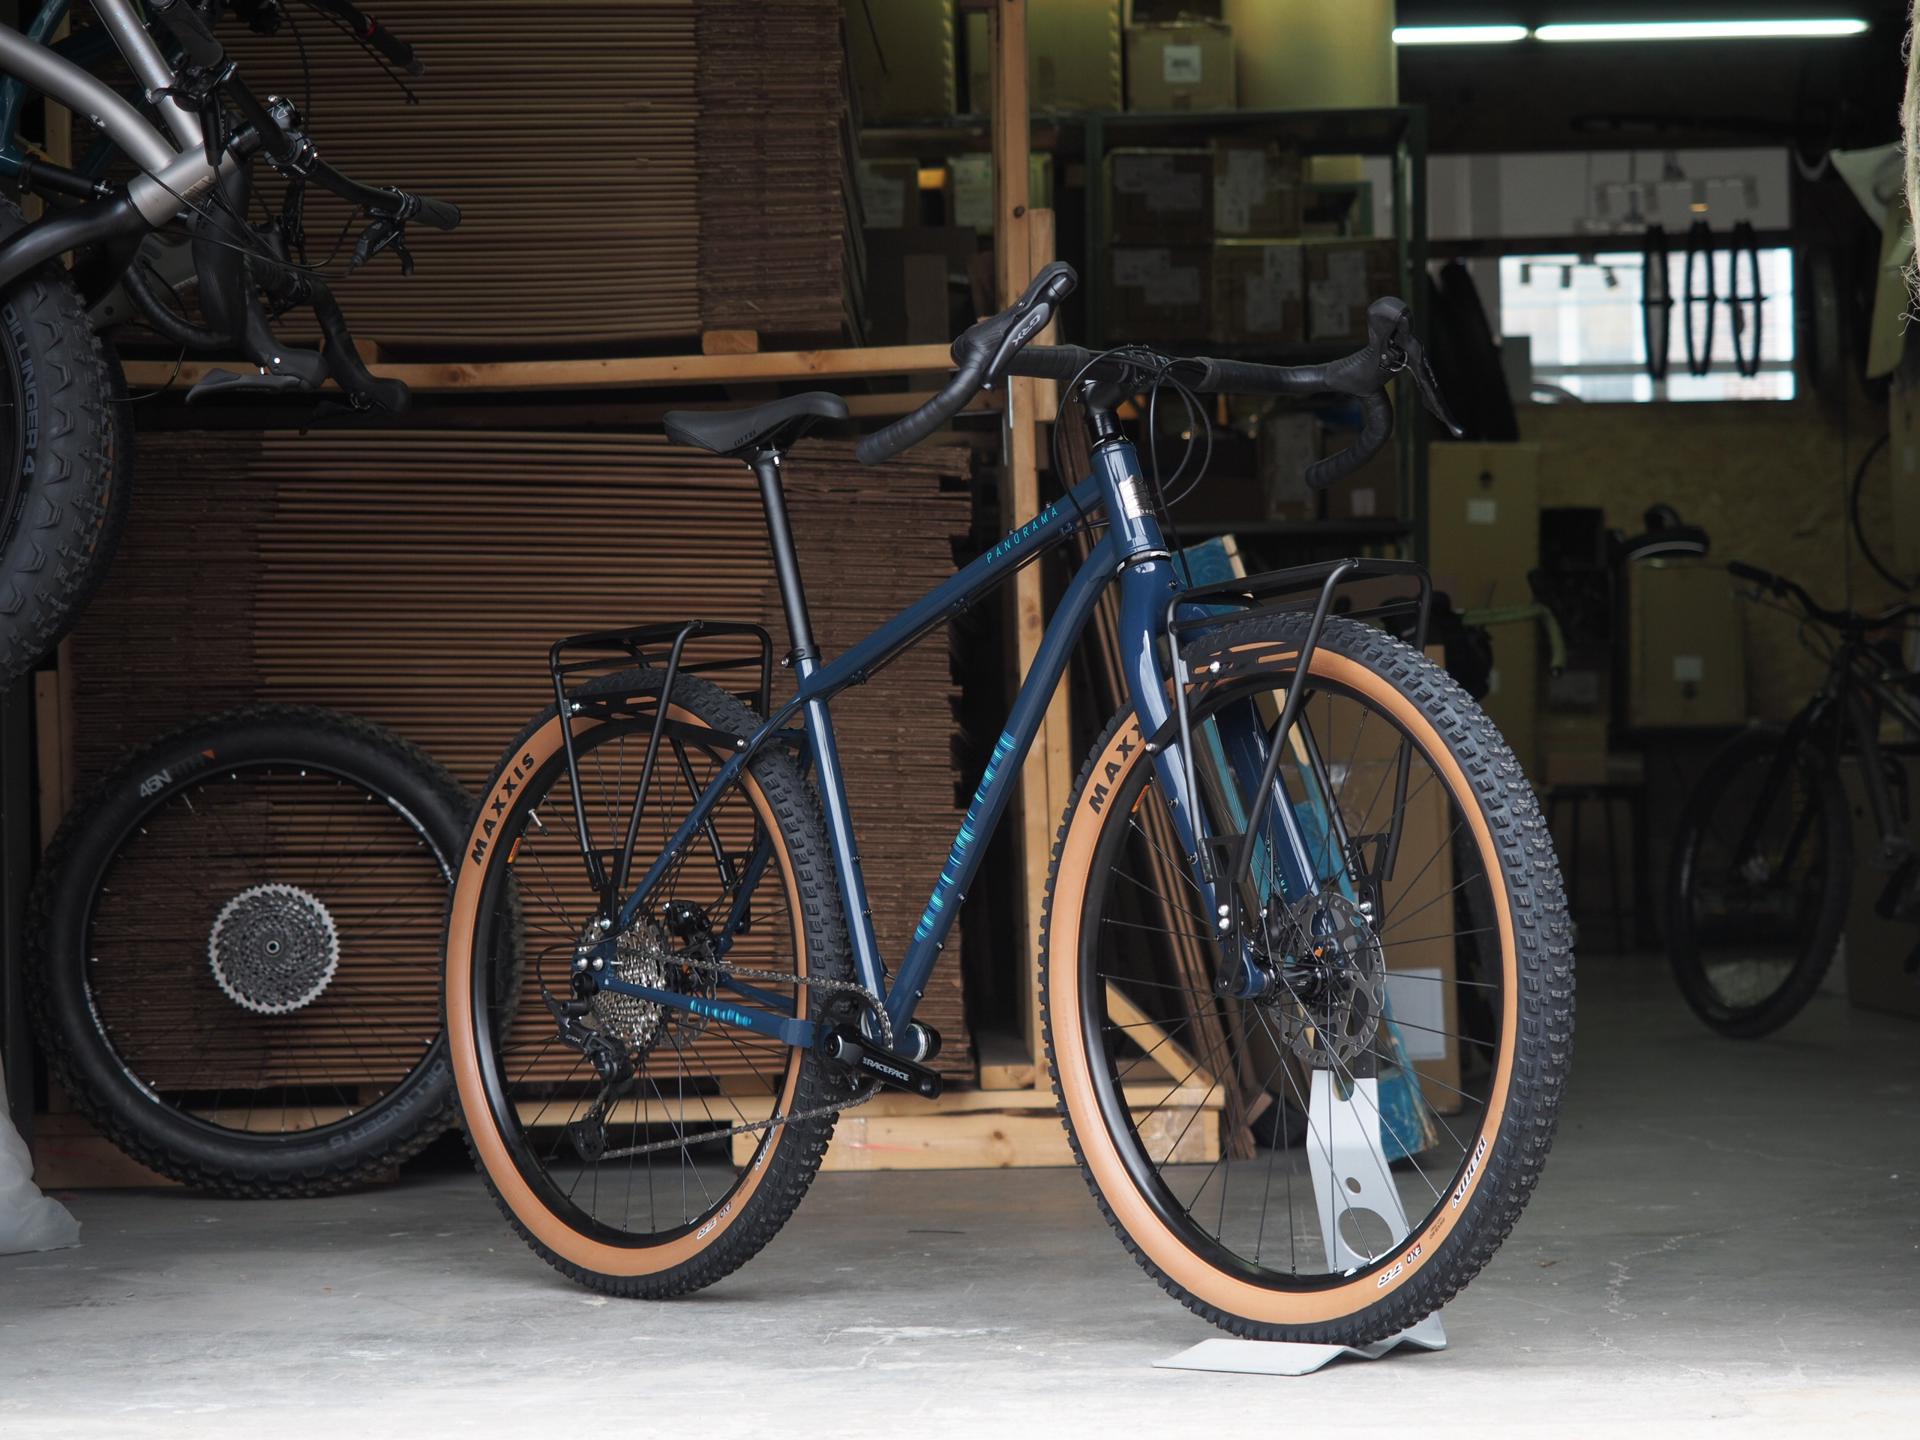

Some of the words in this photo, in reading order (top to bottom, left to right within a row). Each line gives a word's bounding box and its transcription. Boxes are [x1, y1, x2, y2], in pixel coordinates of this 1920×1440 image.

[1012, 314, 1041, 347] GRX
[3, 303, 38, 449] DILLINGER
[22, 455, 35, 476] 4
[986, 506, 1058, 564] PANORAMA
[471, 753, 535, 866] MAXXIS
[866, 1058, 910, 1081] RACEFACE
[348, 1059, 446, 1141] DILLINGER
[1406, 1241, 1423, 1264] EXO
